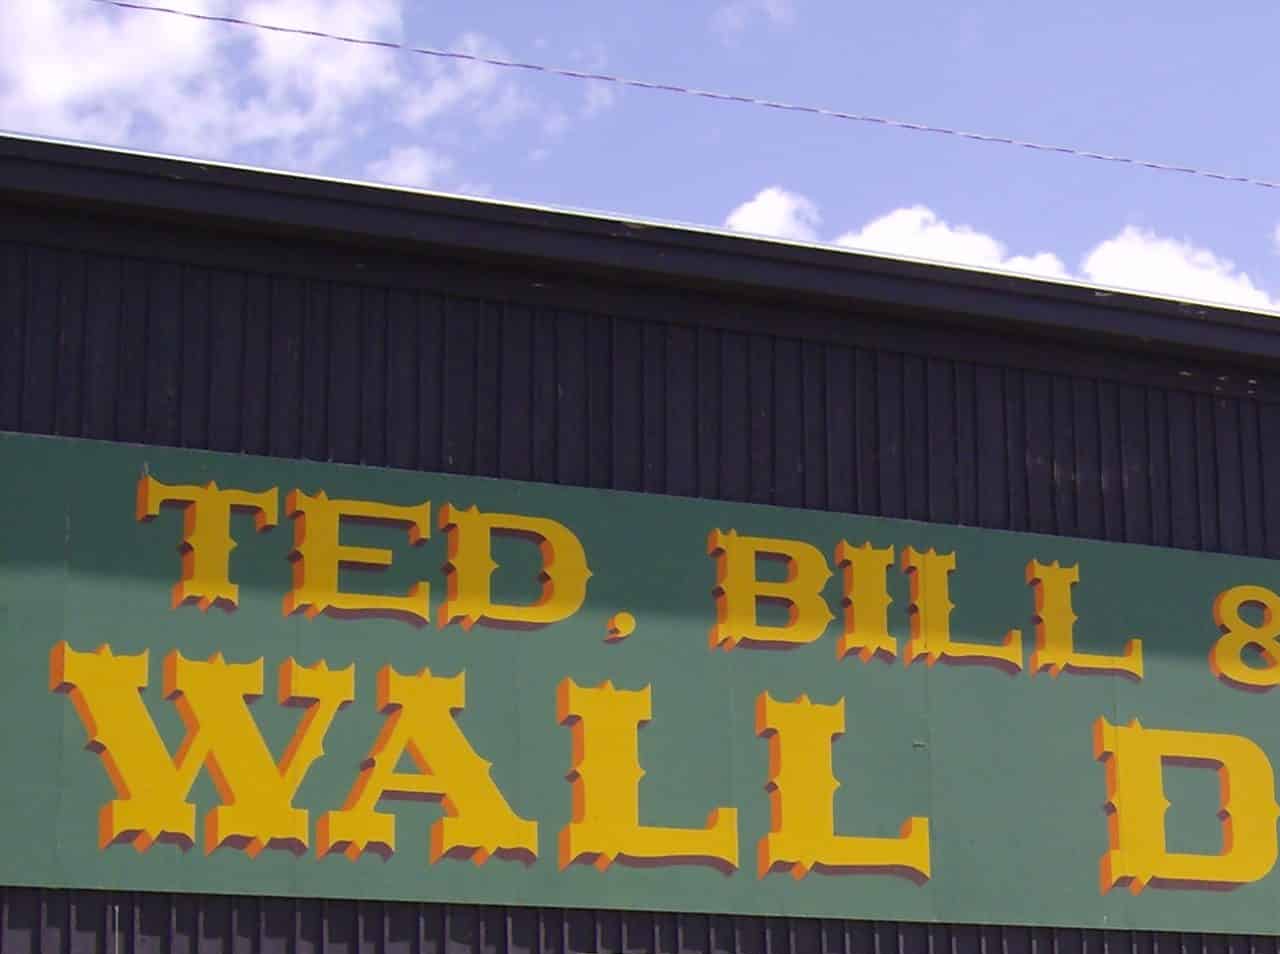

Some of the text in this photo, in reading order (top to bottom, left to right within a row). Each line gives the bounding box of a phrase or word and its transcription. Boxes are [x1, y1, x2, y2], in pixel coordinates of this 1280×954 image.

[136, 475, 636, 643] TED,
[707, 527, 1143, 679] BILL
[50, 640, 931, 880] WALL
